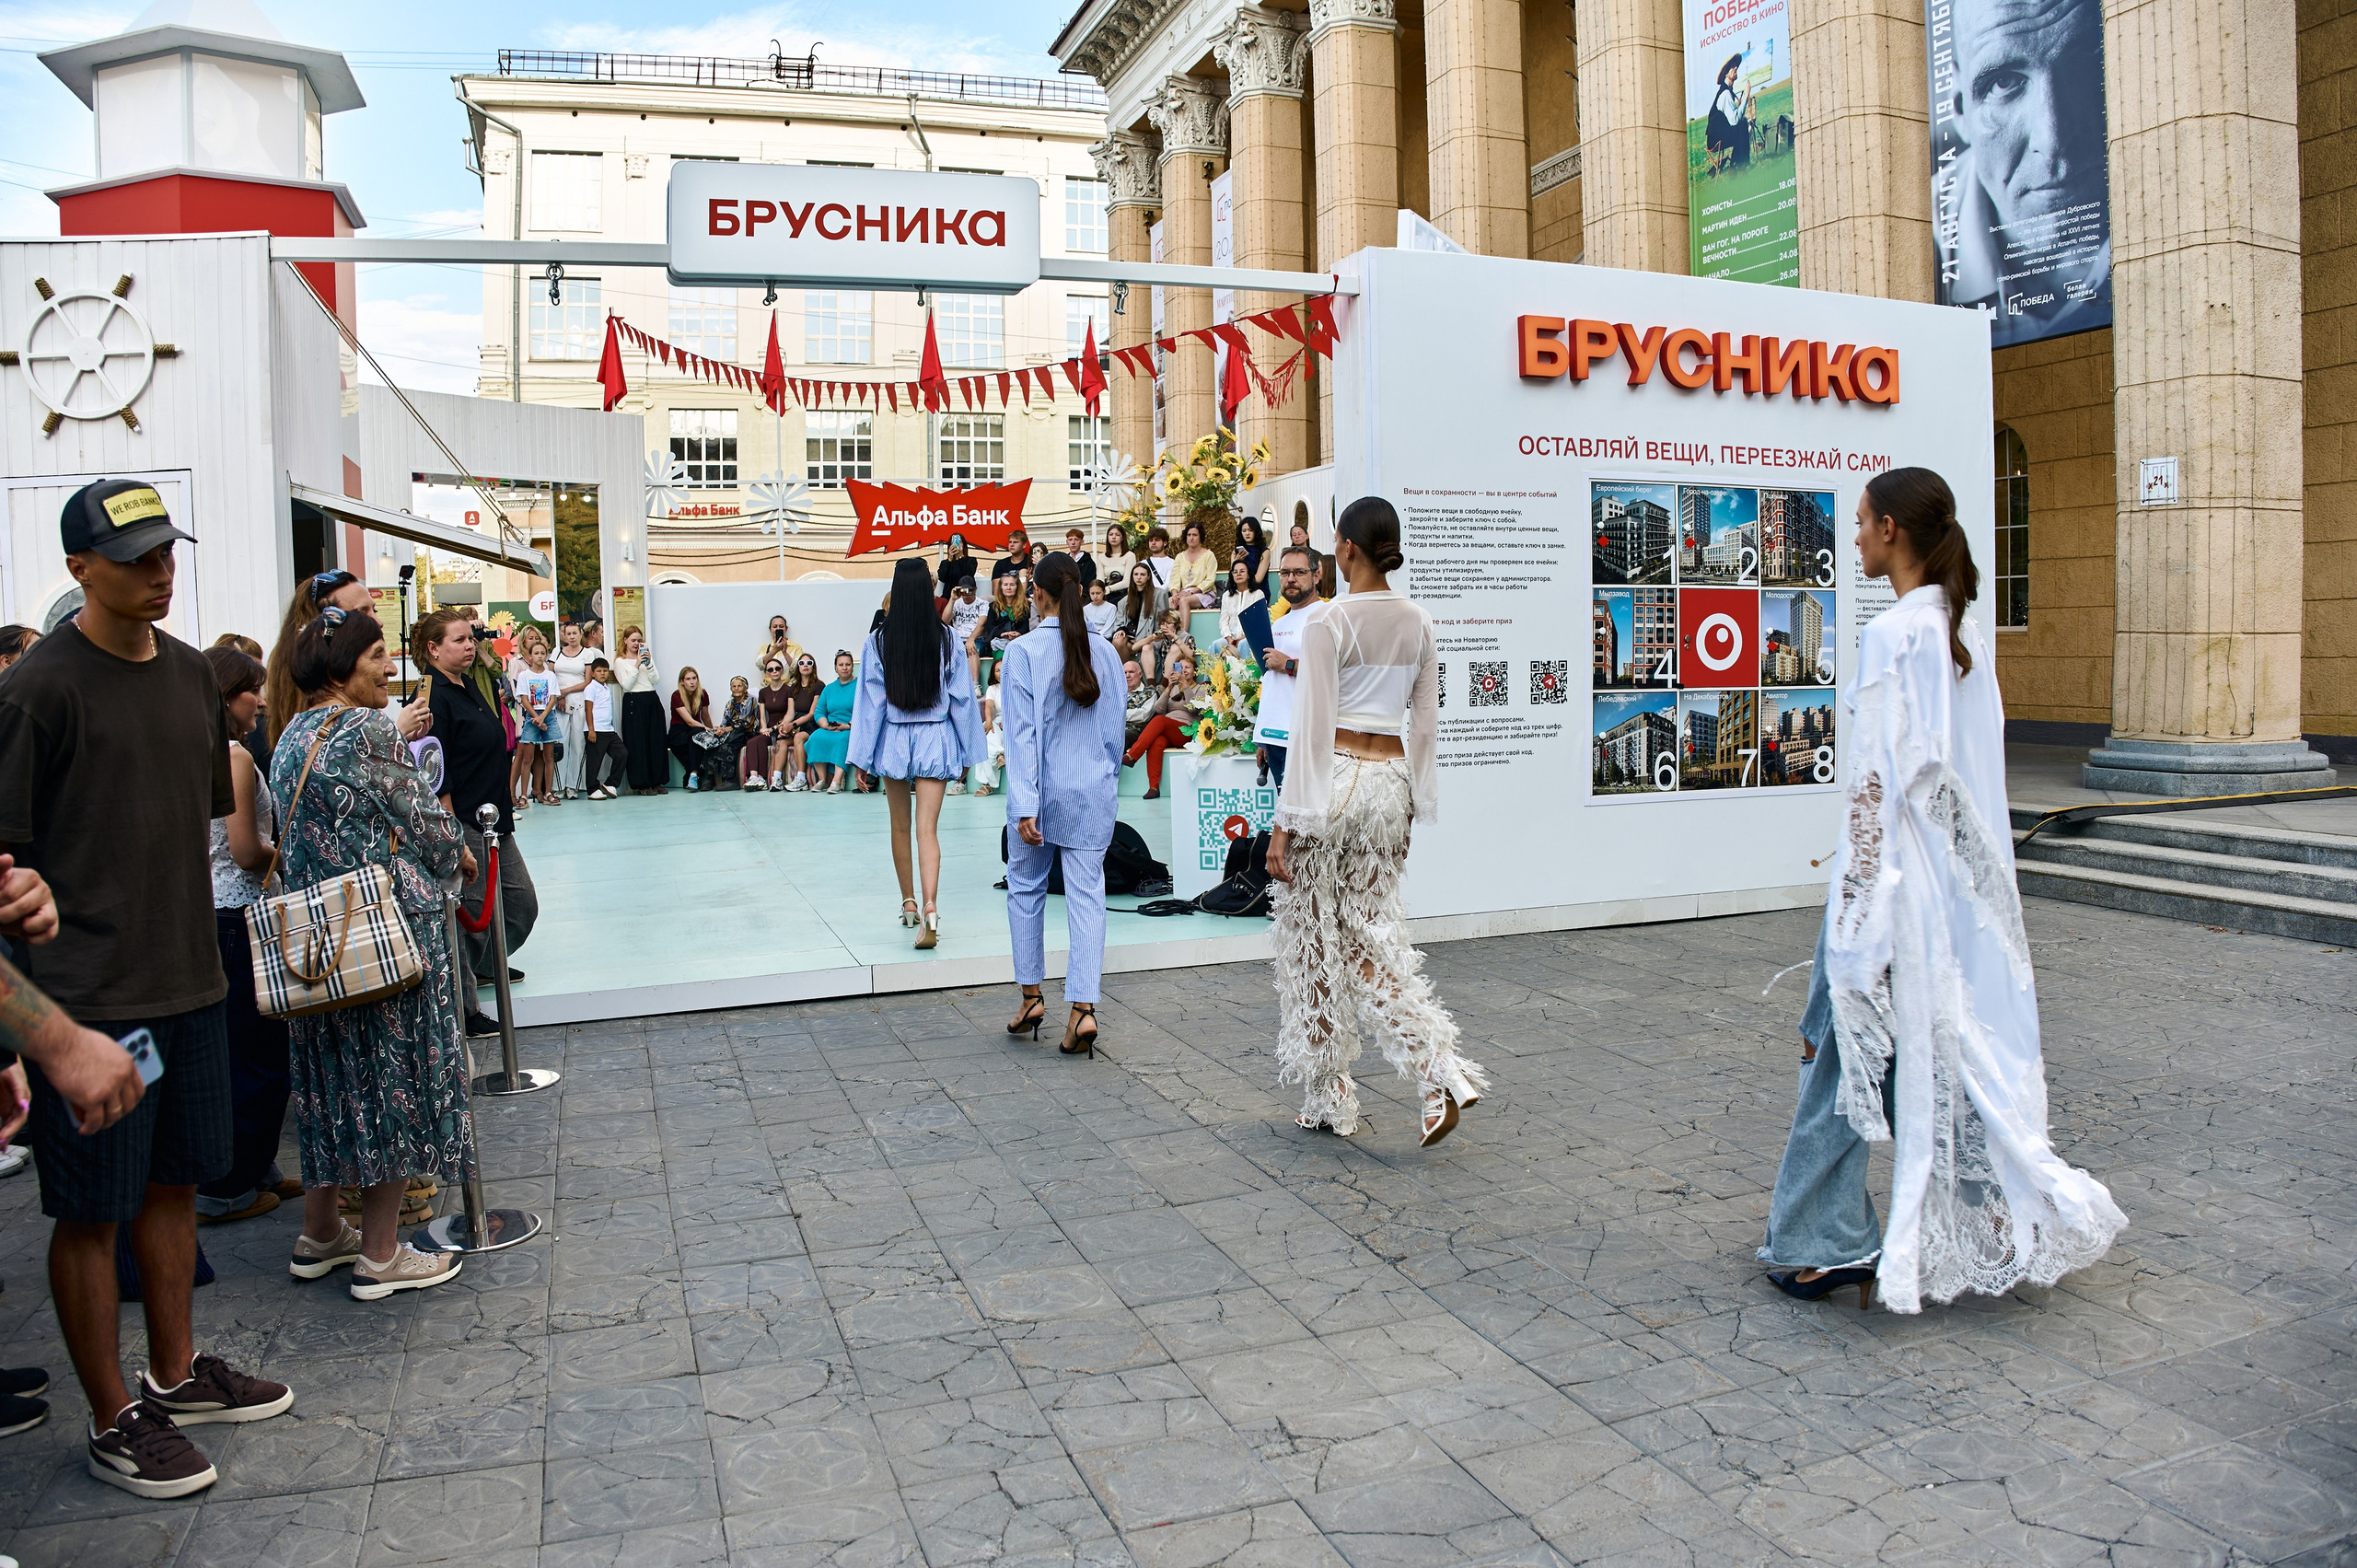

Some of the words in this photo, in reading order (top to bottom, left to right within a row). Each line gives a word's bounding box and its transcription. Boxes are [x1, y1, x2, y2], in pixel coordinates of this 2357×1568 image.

[1701, 18, 1748, 49] ИСКУССТВО
[1752, 15, 1757, 24] В
[1759, 1, 1784, 20] КИНО
[1937, 98, 1954, 125] 19
[1702, 200, 1732, 216] ХОРИСТЫ
[1938, 146, 1959, 254] АВГУСТА
[708, 199, 1005, 247] БРУСНИКА
[1702, 220, 1728, 235] МАРТИН
[1730, 214, 1747, 226] ИДЕН
[1990, 224, 2011, 233] Выставка
[2014, 217, 2038, 227] фотографа
[2039, 210, 2065, 221] Владимира
[2067, 201, 2100, 215] Дубровского
[2033, 223, 2052, 233] история
[2054, 216, 2079, 227] непростой
[2081, 212, 2100, 221] победы
[1702, 243, 1715, 253] ВАН
[1717, 238, 1730, 249] ГОГ.
[1731, 235, 1740, 244] НА
[1742, 226, 1769, 240] ПОРОГЕ
[2007, 238, 2035, 250] Александра
[2037, 232, 2060, 243] Карелина
[2082, 223, 2100, 232] летних
[1703, 248, 1736, 264] ВЕЧНОСТИ
[2004, 248, 2037, 261] Олимпийских
[2038, 245, 2051, 253] играх
[2079, 234, 2099, 243] победы,
[2024, 256, 2045, 266] навсегда
[2046, 249, 2072, 261] вошедшей
[2077, 244, 2099, 255] историю
[1943, 259, 1960, 284] 21
[1997, 269, 2030, 283] греко-римской
[2032, 263, 2049, 275] борьбы
[2056, 259, 2079, 270] мирового
[2067, 284, 2086, 292] белая
[2067, 288, 2094, 300] галерея
[2021, 293, 2054, 308] ПОБЕДА
[1517, 314, 1900, 405] БРУСНИКА
[1518, 435, 1638, 459] ОСТАВЛЯЙ
[1646, 441, 1714, 465] ВЕЩИ,
[1721, 443, 1840, 470] ПЕРЕЕЗЖАЙ
[1848, 450, 1893, 472] САМ!
[1403, 487, 1423, 495] Вещи
[1596, 484, 1634, 493] Европейский
[2154, 475, 2163, 486] 21
[1683, 487, 1727, 497] Город-на-озере
[110, 505, 124, 516] WE
[123, 499, 140, 511] ROB
[140, 497, 160, 506] BANKS
[669, 504, 707, 517] льфа
[711, 504, 739, 515] Банк
[1464, 507, 1499, 516] свободную
[872, 505, 947, 530] Альфа
[953, 505, 1010, 525] Банк
[1408, 523, 1448, 531] Пожалуйста,
[1663, 546, 1676, 584] 1
[1737, 547, 1758, 586] 2
[1816, 549, 1834, 587] 3
[1449, 583, 1474, 591] забрать
[1599, 589, 1630, 598] Мылзавод
[1765, 591, 1794, 599] Молодость
[1462, 617, 1494, 625] заберите
[1654, 649, 1676, 688] 4
[1816, 647, 1834, 684] 5
[1692, 692, 1729, 702] Декабристов
[1765, 691, 1788, 700] Авиатор
[1452, 734, 1503, 742] арт-резиденцию
[1654, 751, 1676, 791] 6
[1737, 749, 1757, 786] 7
[1813, 745, 1834, 783] 8
